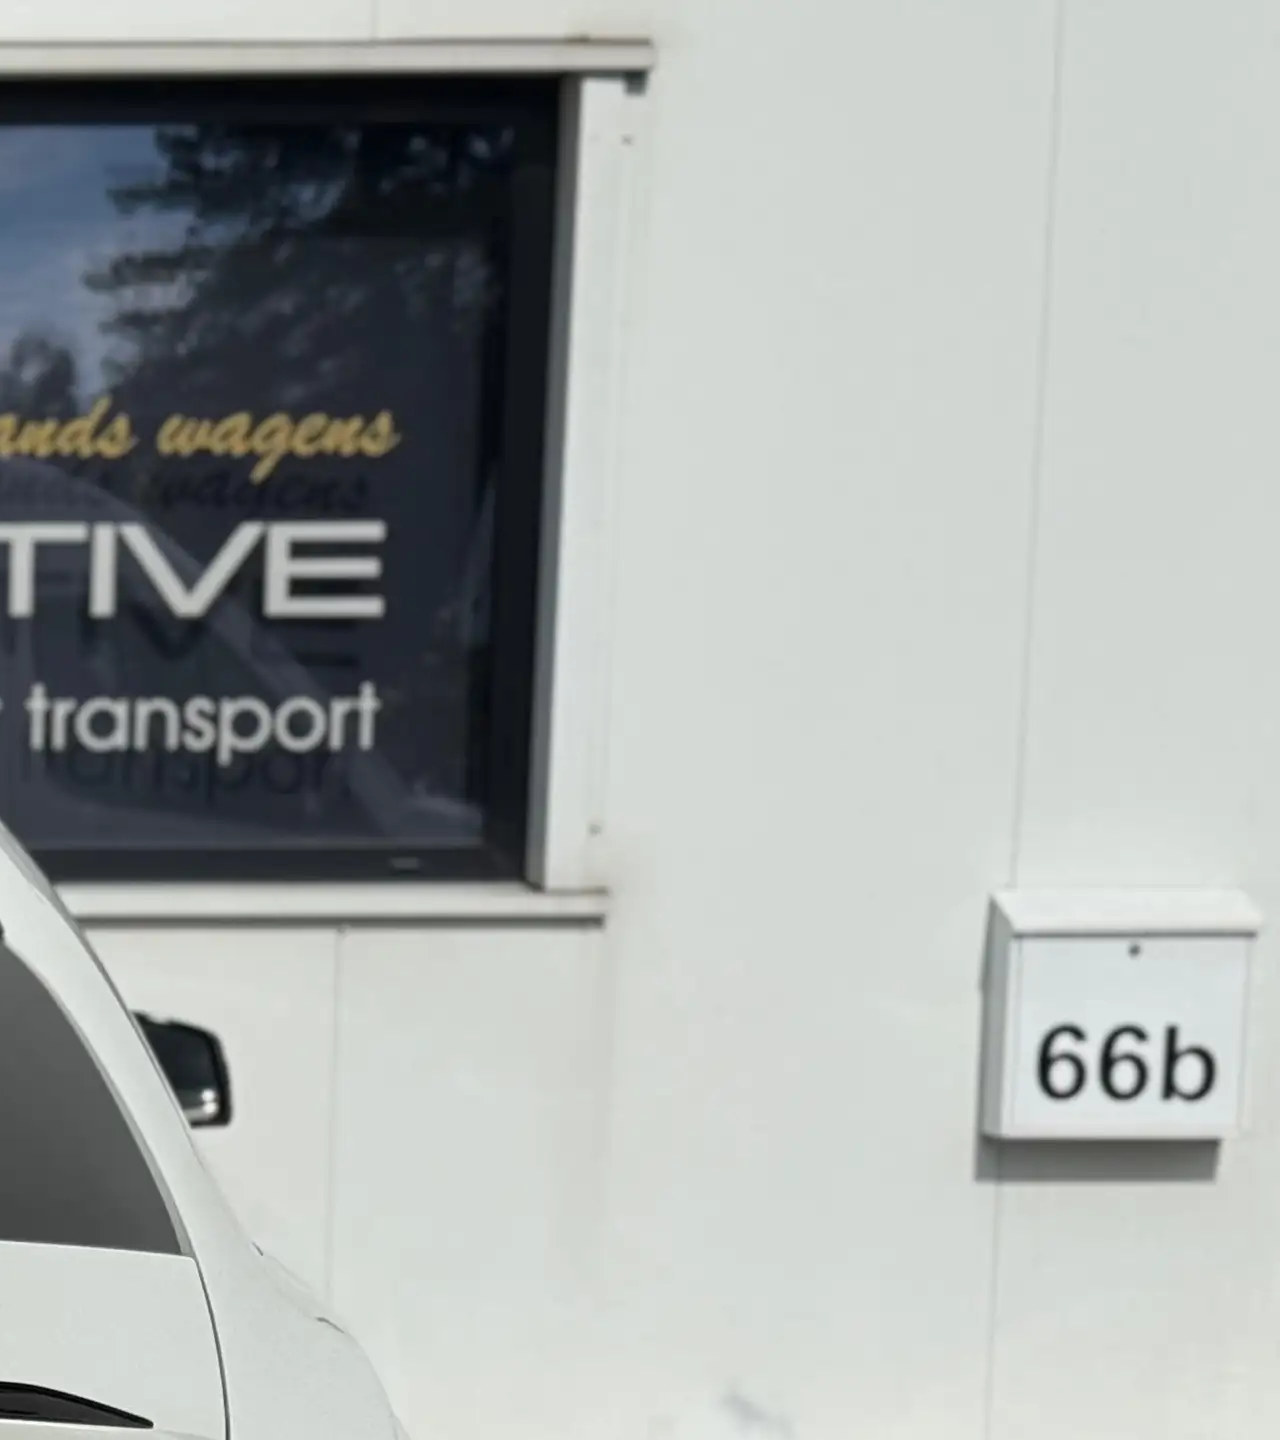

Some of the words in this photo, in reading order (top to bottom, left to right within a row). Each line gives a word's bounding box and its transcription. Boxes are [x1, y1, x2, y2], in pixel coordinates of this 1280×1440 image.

[155, 409, 398, 484] wagens
[24, 681, 381, 766] transport
[1036, 1022, 1217, 1102] 66b
